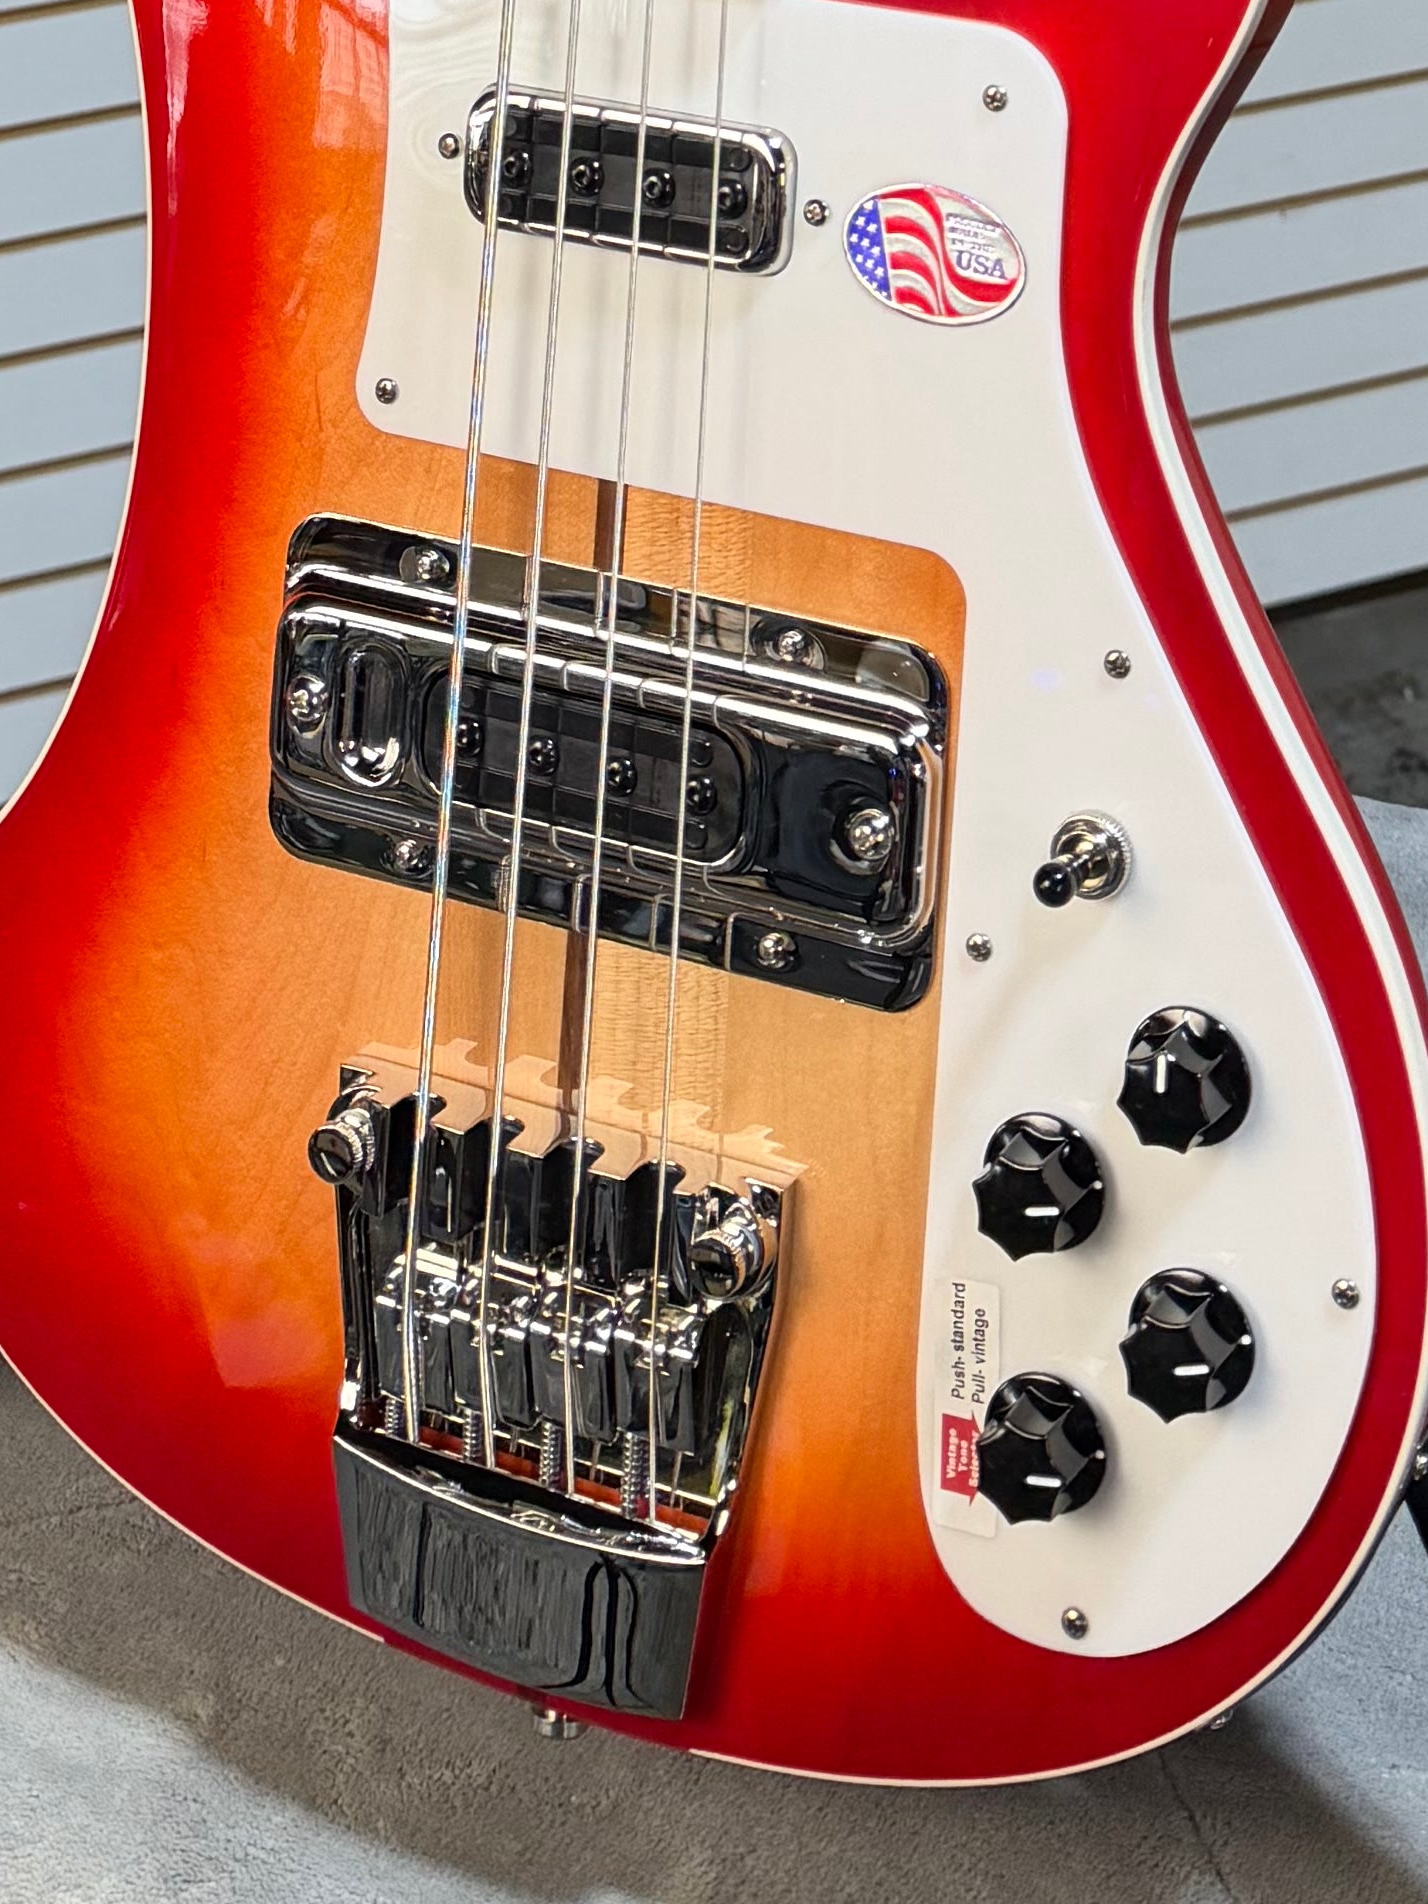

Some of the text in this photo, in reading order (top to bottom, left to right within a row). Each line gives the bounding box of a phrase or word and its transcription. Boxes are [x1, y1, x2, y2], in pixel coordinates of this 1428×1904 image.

[955, 249, 1009, 281] USA
[950, 1282, 966, 1353] standard
[972, 1307, 989, 1366] vintage
[945, 1427, 959, 1480] Vintage
[957, 1438, 969, 1473] Tone
